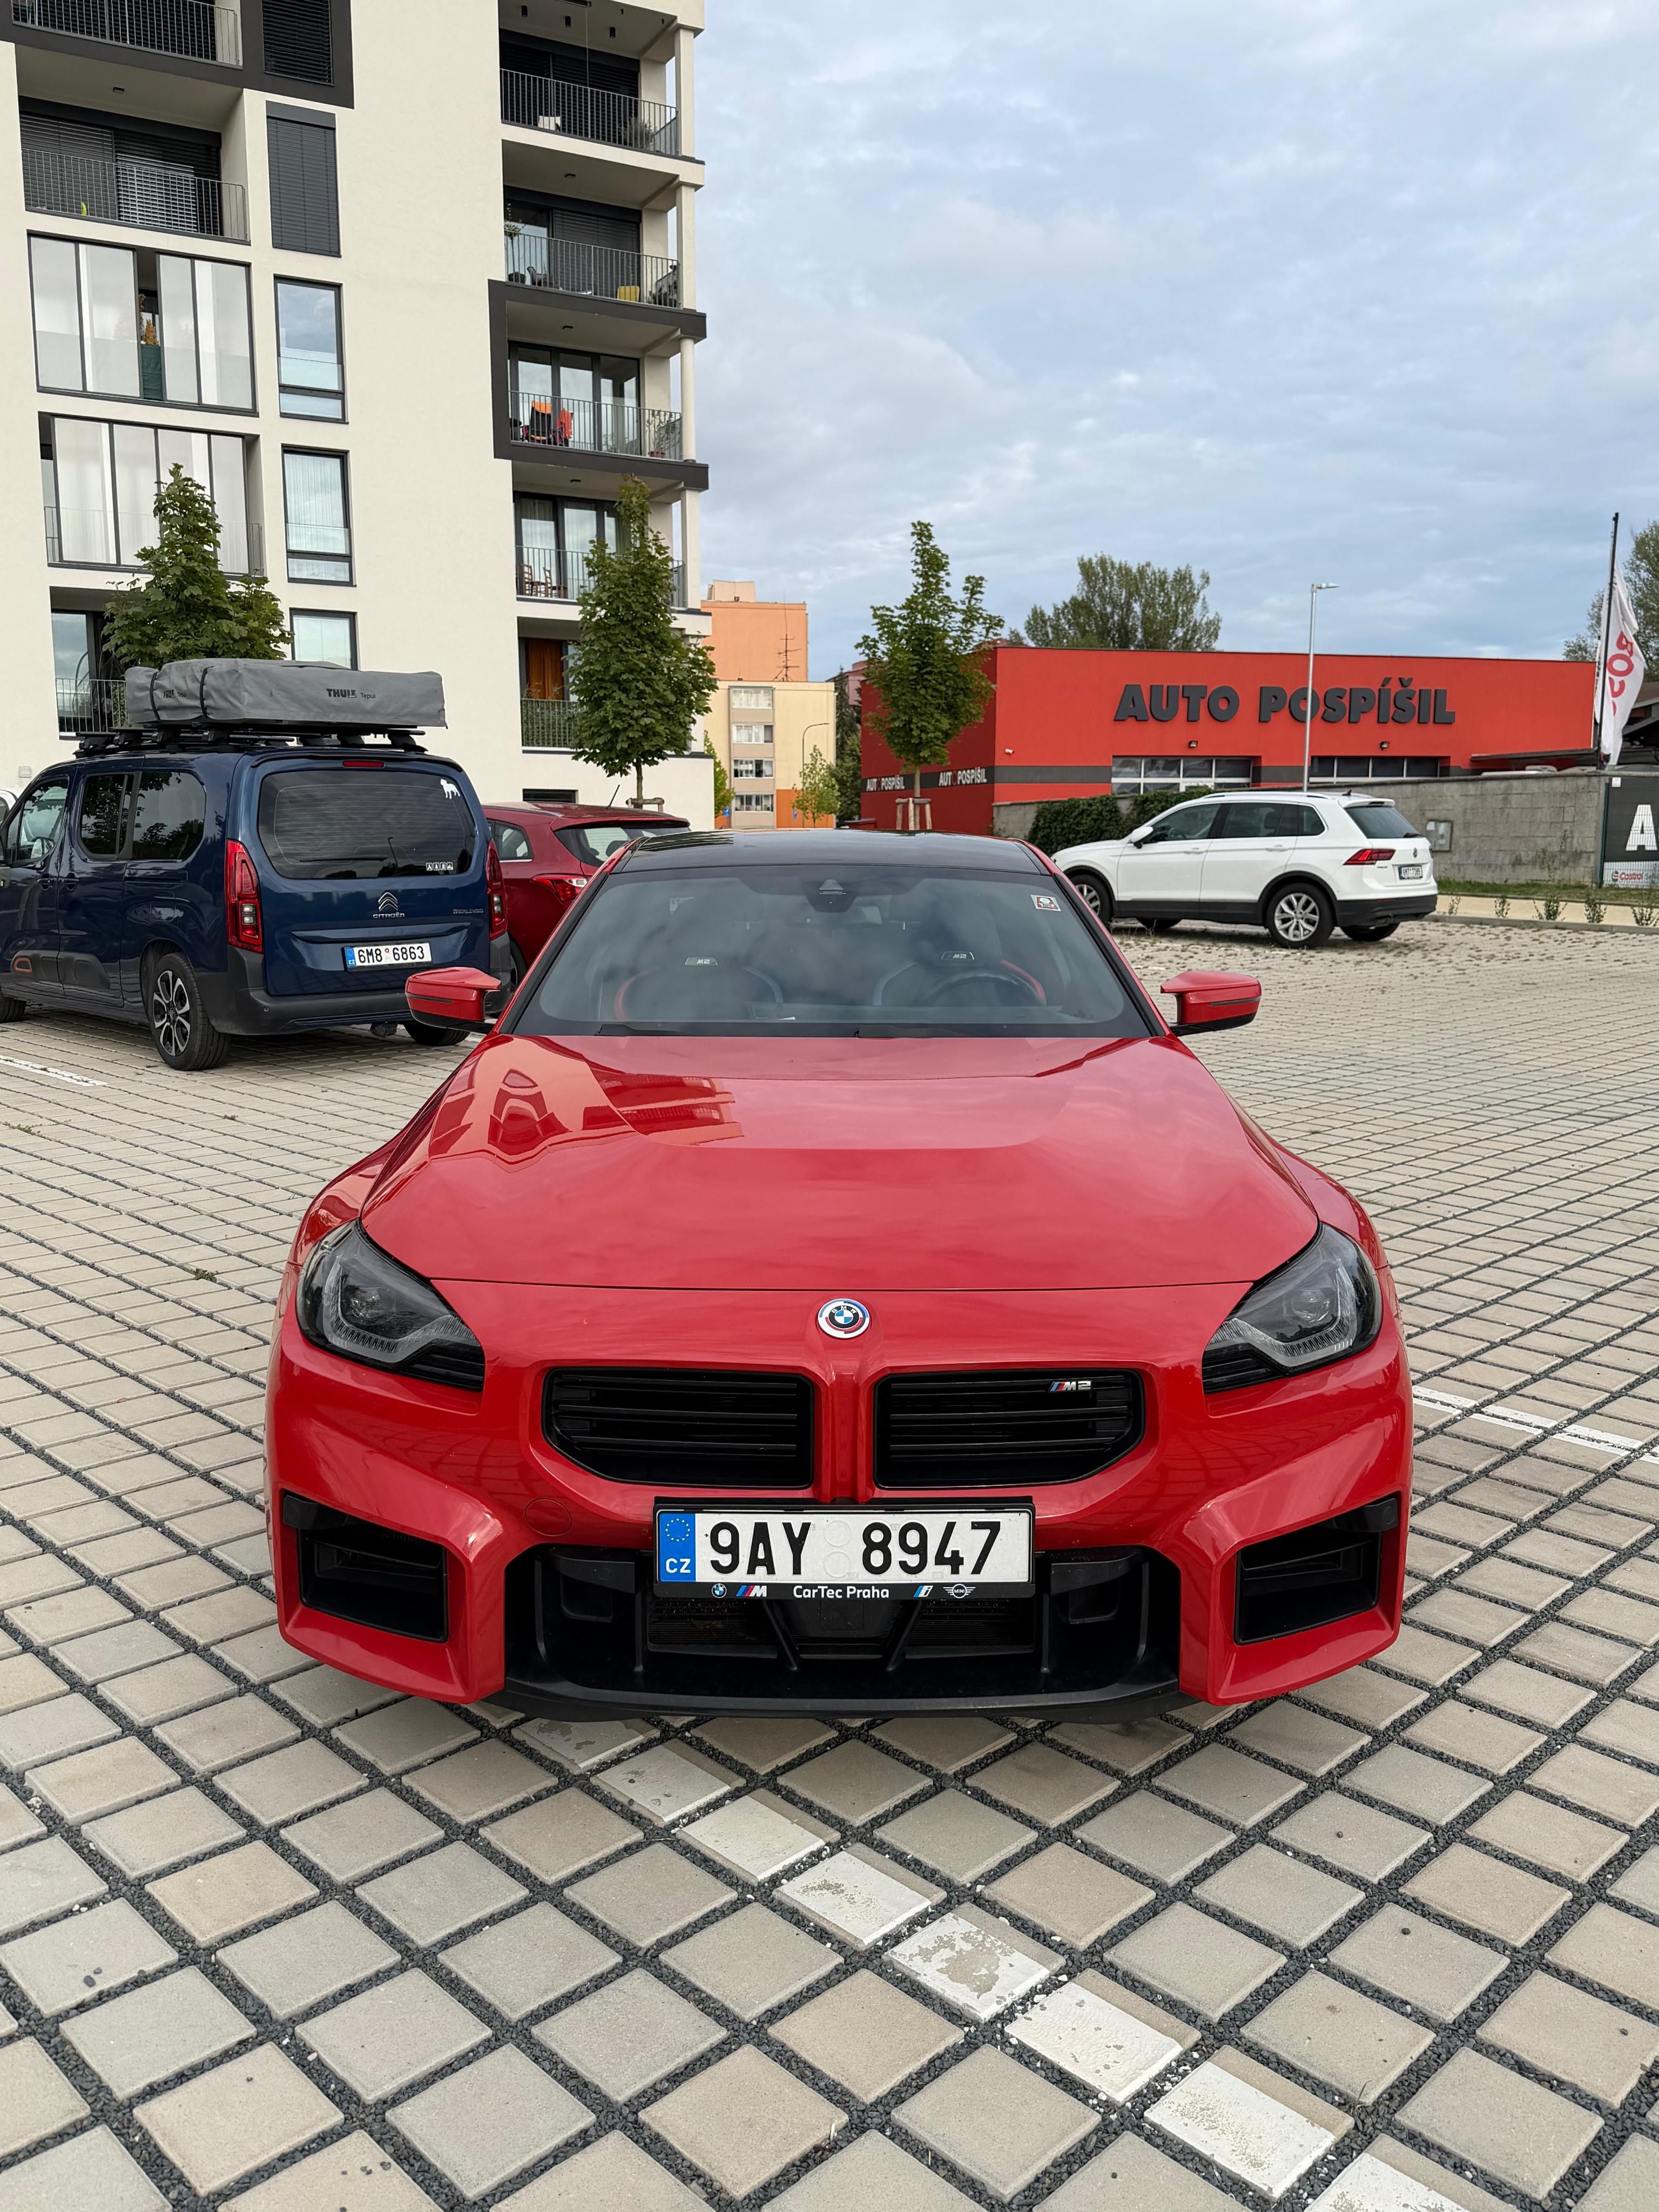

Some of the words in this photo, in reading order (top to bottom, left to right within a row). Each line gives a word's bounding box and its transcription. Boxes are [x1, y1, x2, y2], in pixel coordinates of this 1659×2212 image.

[326, 688, 357, 698] THULE
[360, 692, 376, 700] Tepui
[1113, 684, 1240, 722] AUTO
[1258, 677, 1456, 724] POSPÍŠIL
[957, 767, 987, 785] POSPÍŠIL
[1625, 804, 1659, 851] A
[358, 948, 382, 963] 6M8
[392, 946, 424, 961] 6863
[832, 1305, 857, 1314] BMW
[1062, 1380, 1091, 1392] M2
[709, 1521, 812, 1575] 9AY
[862, 1521, 1001, 1575] 8947
[665, 1557, 691, 1574] CZ
[793, 1585, 842, 1599] CarTec
[846, 1586, 889, 1599] Praha
